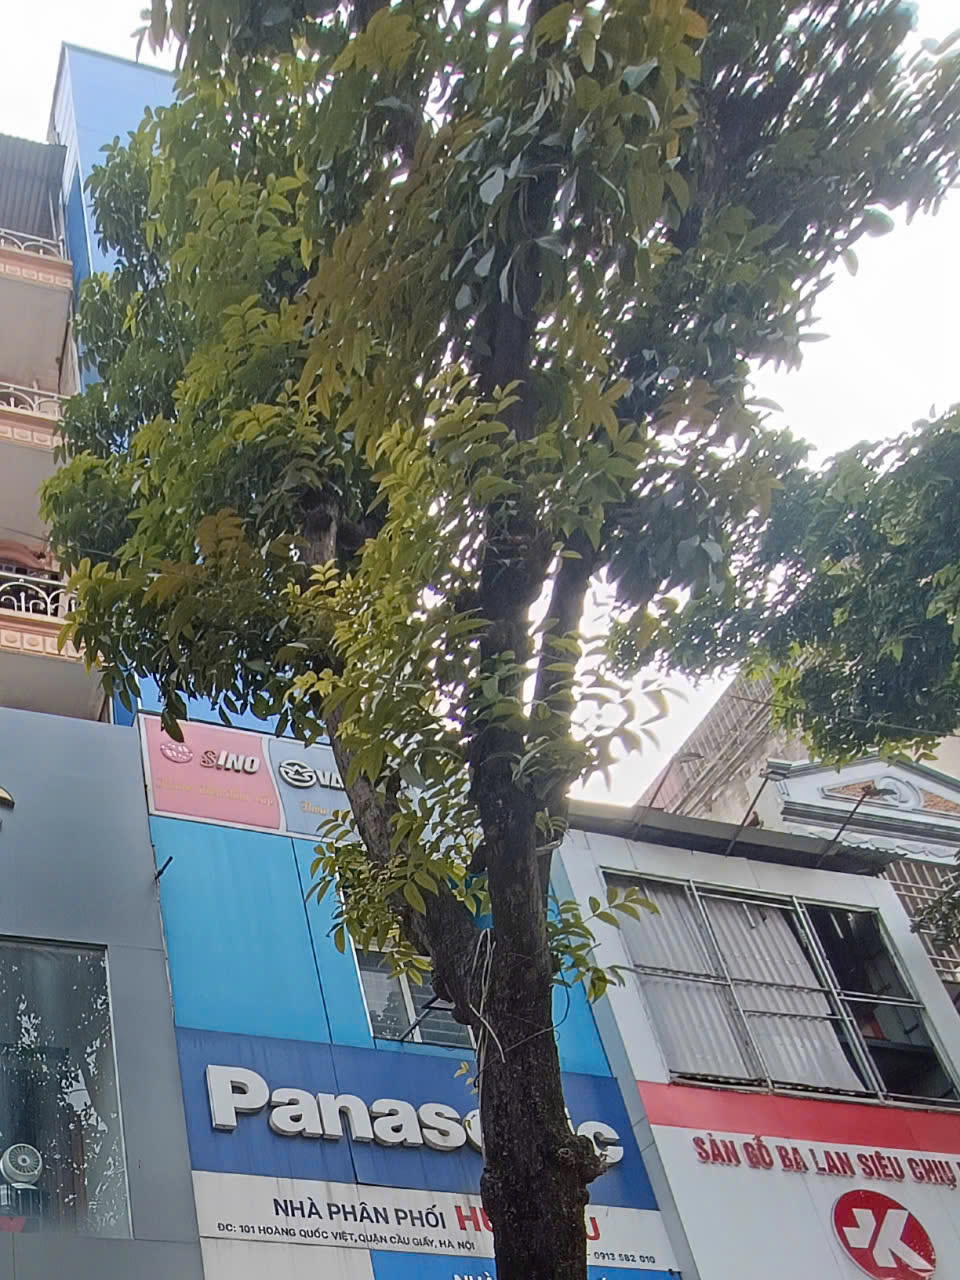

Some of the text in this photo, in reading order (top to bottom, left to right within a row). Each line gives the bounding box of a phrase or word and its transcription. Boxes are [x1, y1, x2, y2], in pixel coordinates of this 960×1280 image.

[200, 750, 260, 774] SINO
[206, 1064, 624, 1163] Panasc
[775, 1145, 808, 1173] BA
[808, 1148, 856, 1179] LAN
[273, 1197, 323, 1220] NHÀ
[327, 1202, 390, 1225] PHÂN
[395, 1204, 447, 1229] PHỐI
[239, 1224, 255, 1234] 101
[258, 1224, 296, 1237] HOÀNG
[594, 1251, 616, 1261] 0913
